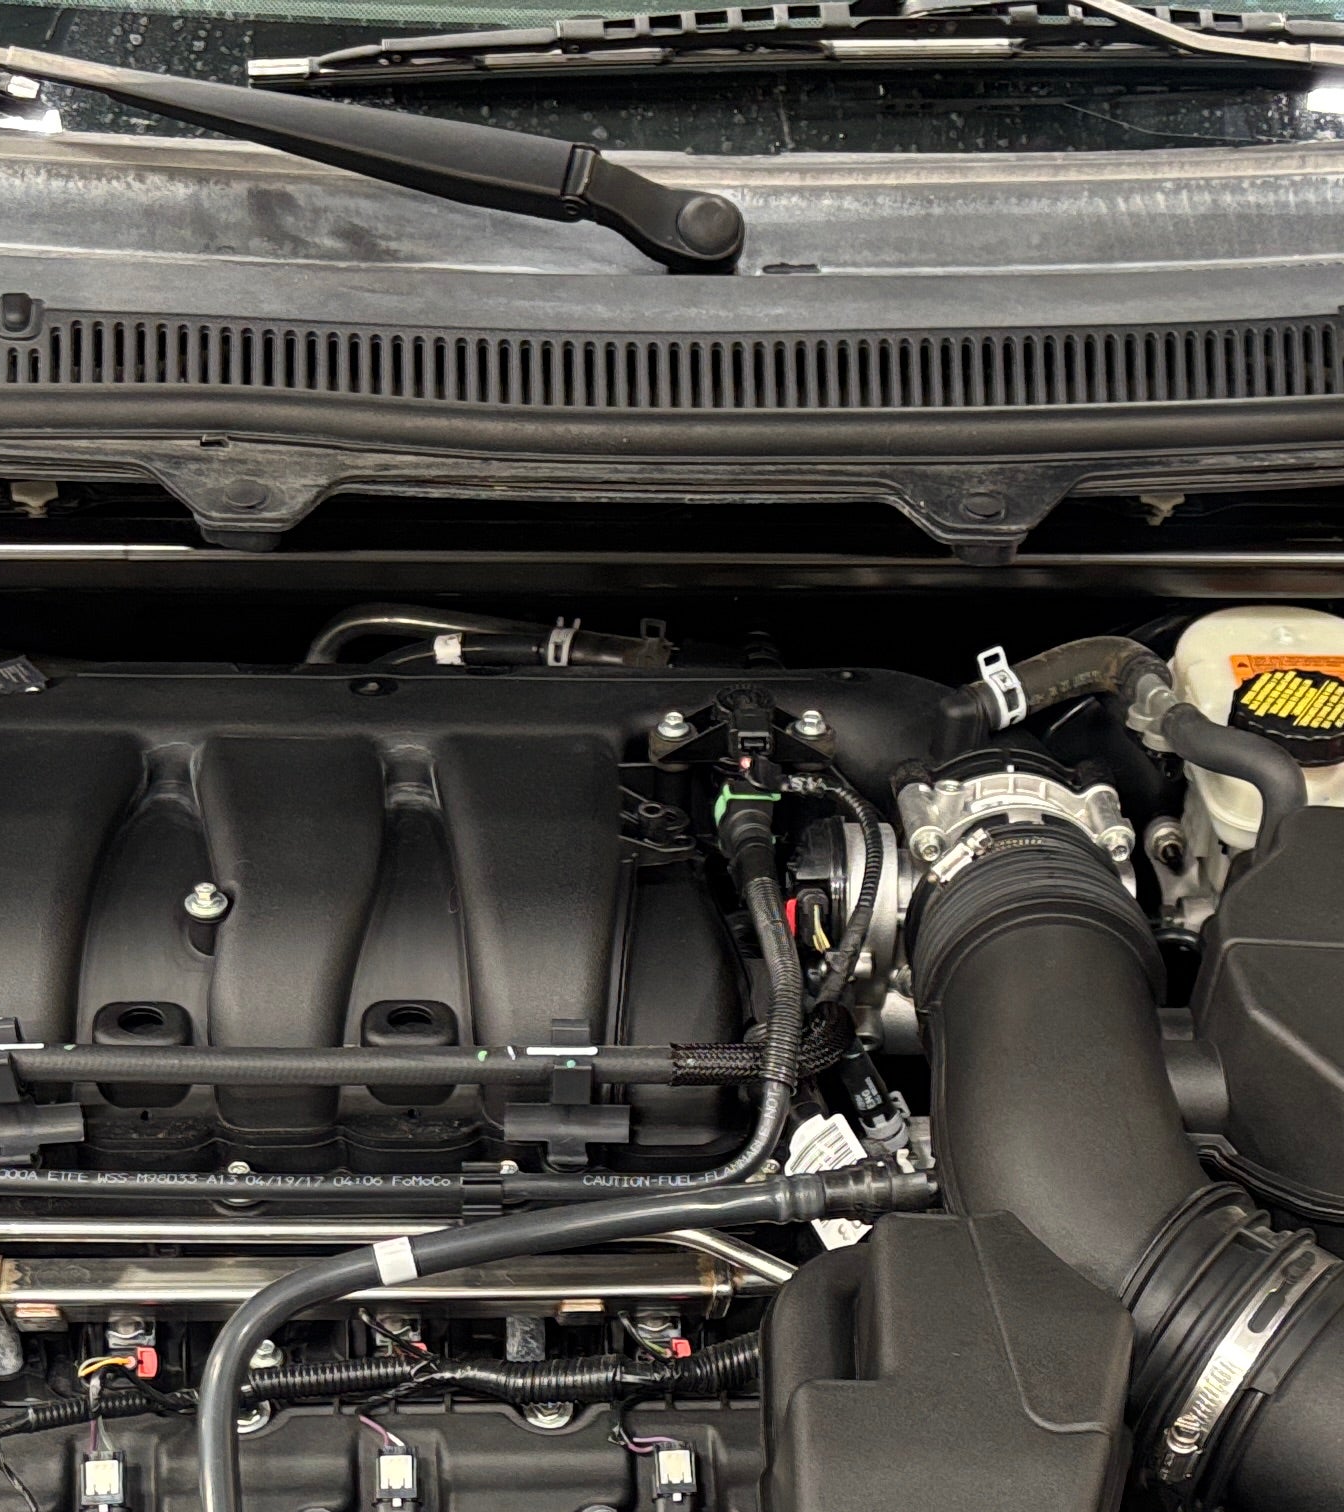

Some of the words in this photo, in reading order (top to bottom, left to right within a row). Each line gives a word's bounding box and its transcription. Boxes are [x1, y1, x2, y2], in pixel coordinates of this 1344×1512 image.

[47, 1172, 89, 1183] ETFE
[245, 1175, 322, 1187] 04/19/17
[333, 1176, 384, 1187] 04:06
[391, 1176, 452, 1187] FoMoCo
